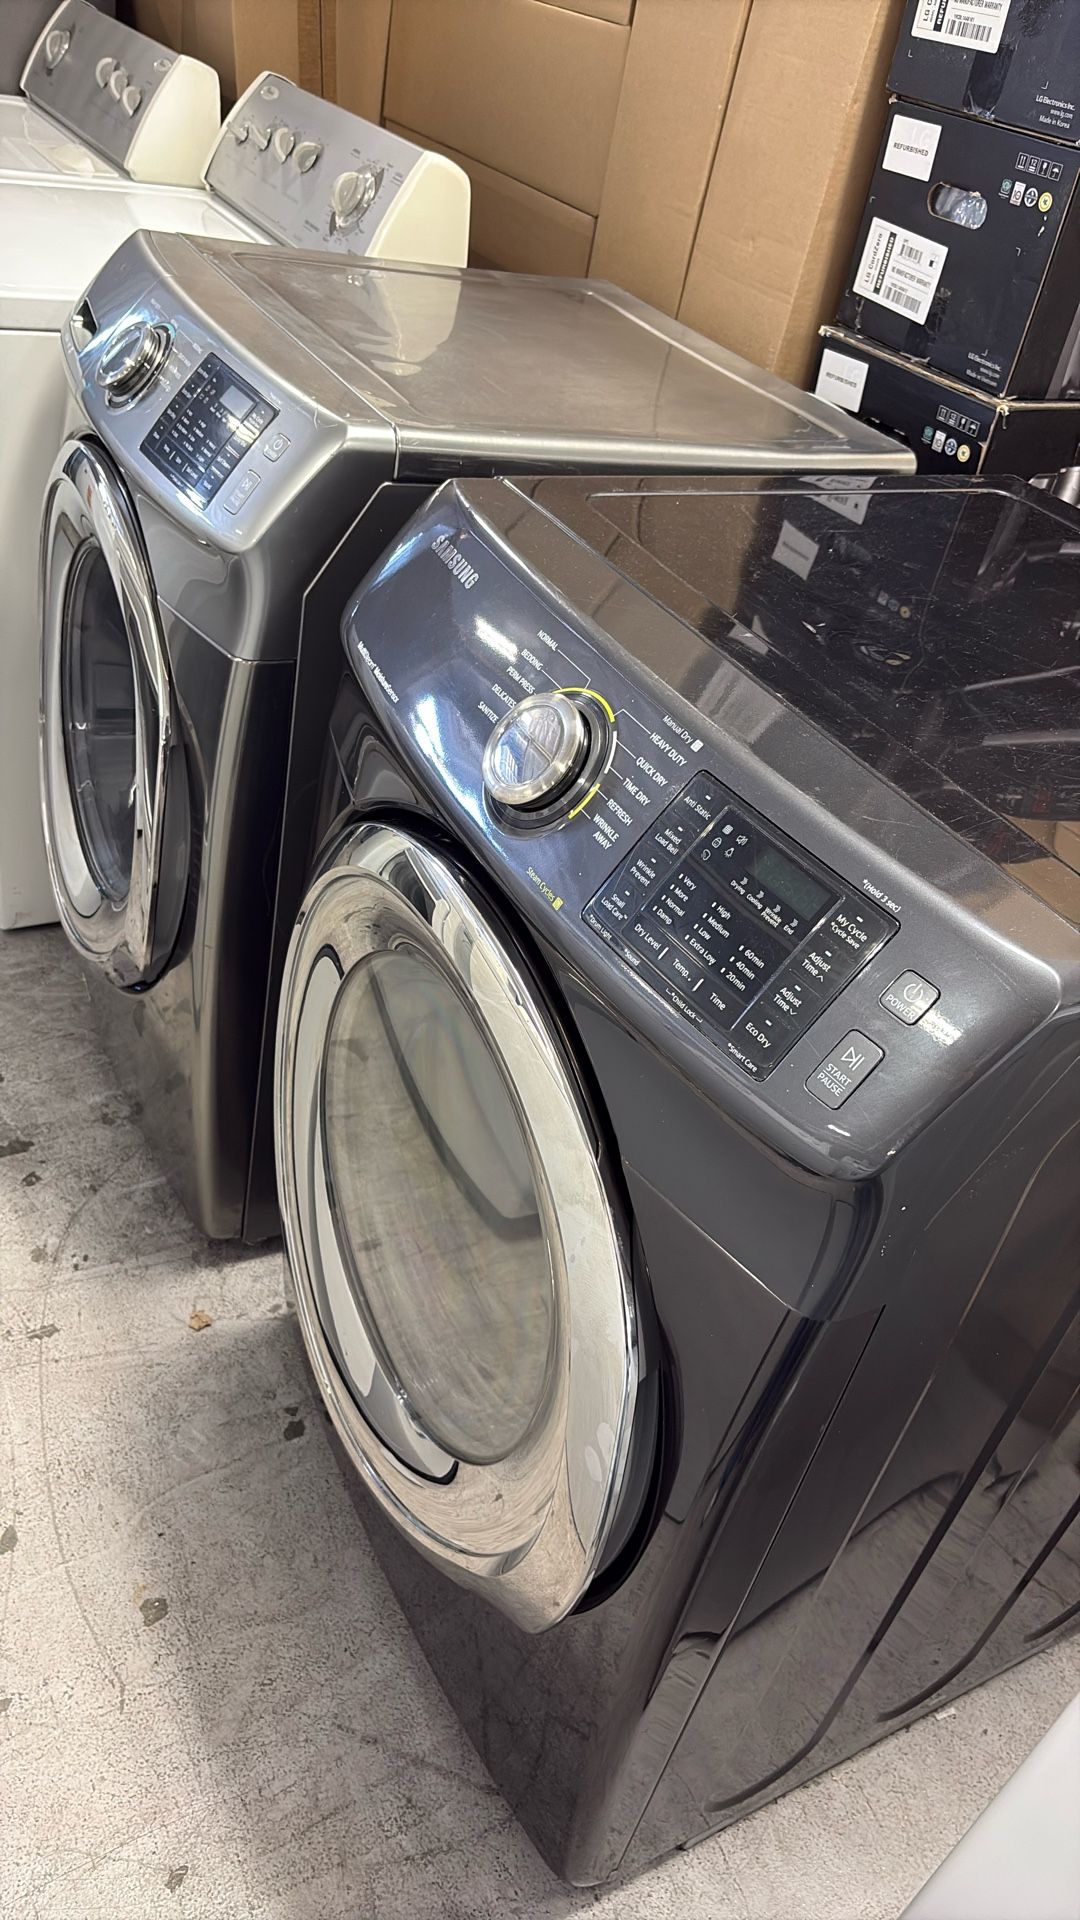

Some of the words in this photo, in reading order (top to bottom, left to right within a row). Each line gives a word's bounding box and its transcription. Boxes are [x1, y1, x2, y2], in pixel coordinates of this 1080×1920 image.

[1036, 94, 1043, 102] LG
[1043, 96, 1068, 108] Electronics
[1039, 115, 1051, 124] Made
[1057, 120, 1070, 128] Korea
[893, 142, 929, 156] REFURBISHED
[868, 233, 883, 270] CordZero
[876, 236, 894, 289] REFURBISHED
[431, 534, 479, 589] SAMSUNG
[537, 630, 558, 651] NORMAL
[521, 649, 543, 671] BEDDING
[506, 666, 521, 682] PERM
[519, 678, 535, 694] PRESS
[492, 683, 517, 708] DELICATES
[478, 701, 499, 724] SANITIZE
[662, 715, 682, 735] Manual
[680, 731, 693, 745] Dry
[650, 732, 671, 753] HEAVY
[668, 749, 687, 766] DUTY
[636, 757, 656, 778] QUICK
[652, 772, 668, 787] DRY
[622, 778, 638, 796] TIME
[635, 791, 651, 806] DRY
[606, 799, 633, 826] REFRESH
[684, 796, 697, 808] Anti
[695, 804, 711, 820] Static
[592, 813, 619, 842] WRINKLE
[664, 829, 682, 844] Mixed
[592, 831, 612, 850] AWAY
[654, 833, 668, 847] Load
[666, 842, 679, 855] Bell
[630, 866, 650, 887] Prevent
[636, 859, 656, 879] Wrinkle
[526, 866, 541, 884] Steam
[539, 882, 555, 902] Cycles
[684, 876, 696, 891] Very
[730, 880, 746, 895] Drying
[601, 897, 614, 911] Load
[611, 893, 626, 909] Small
[674, 887, 689, 902] More
[746, 894, 763, 910] Cooling
[656, 908, 673, 925] Damp
[666, 897, 685, 917] Normal
[717, 905, 731, 920] High
[886, 900, 901, 913] sec)
[707, 916, 730, 938] Medium
[761, 911, 778, 928] Prevent
[783, 924, 794, 935] End
[836, 914, 849, 927] My
[848, 924, 868, 942] Cycle
[600, 927, 612, 940] Light
[634, 924, 646, 938] Dry
[644, 933, 662, 950] Level
[698, 927, 712, 941] Low
[845, 936, 860, 949] Save
[689, 938, 705, 954] Extra
[702, 950, 716, 966] Low
[744, 949, 765, 968] 60min
[808, 952, 832, 972] Adjust
[735, 961, 756, 980] 40min
[802, 959, 818, 976] Time
[726, 972, 746, 991] 20min
[709, 993, 726, 1011] Time
[774, 994, 790, 1011] Time
[780, 987, 802, 1008] Adjust
[885, 994, 916, 1020] POWER
[684, 1005, 697, 1019] Lock
[745, 1023, 760, 1037] Eco
[757, 1033, 771, 1048] Dry
[744, 1059, 758, 1073] Care
[826, 1063, 852, 1086] START
[817, 1073, 844, 1096] PAUSE
